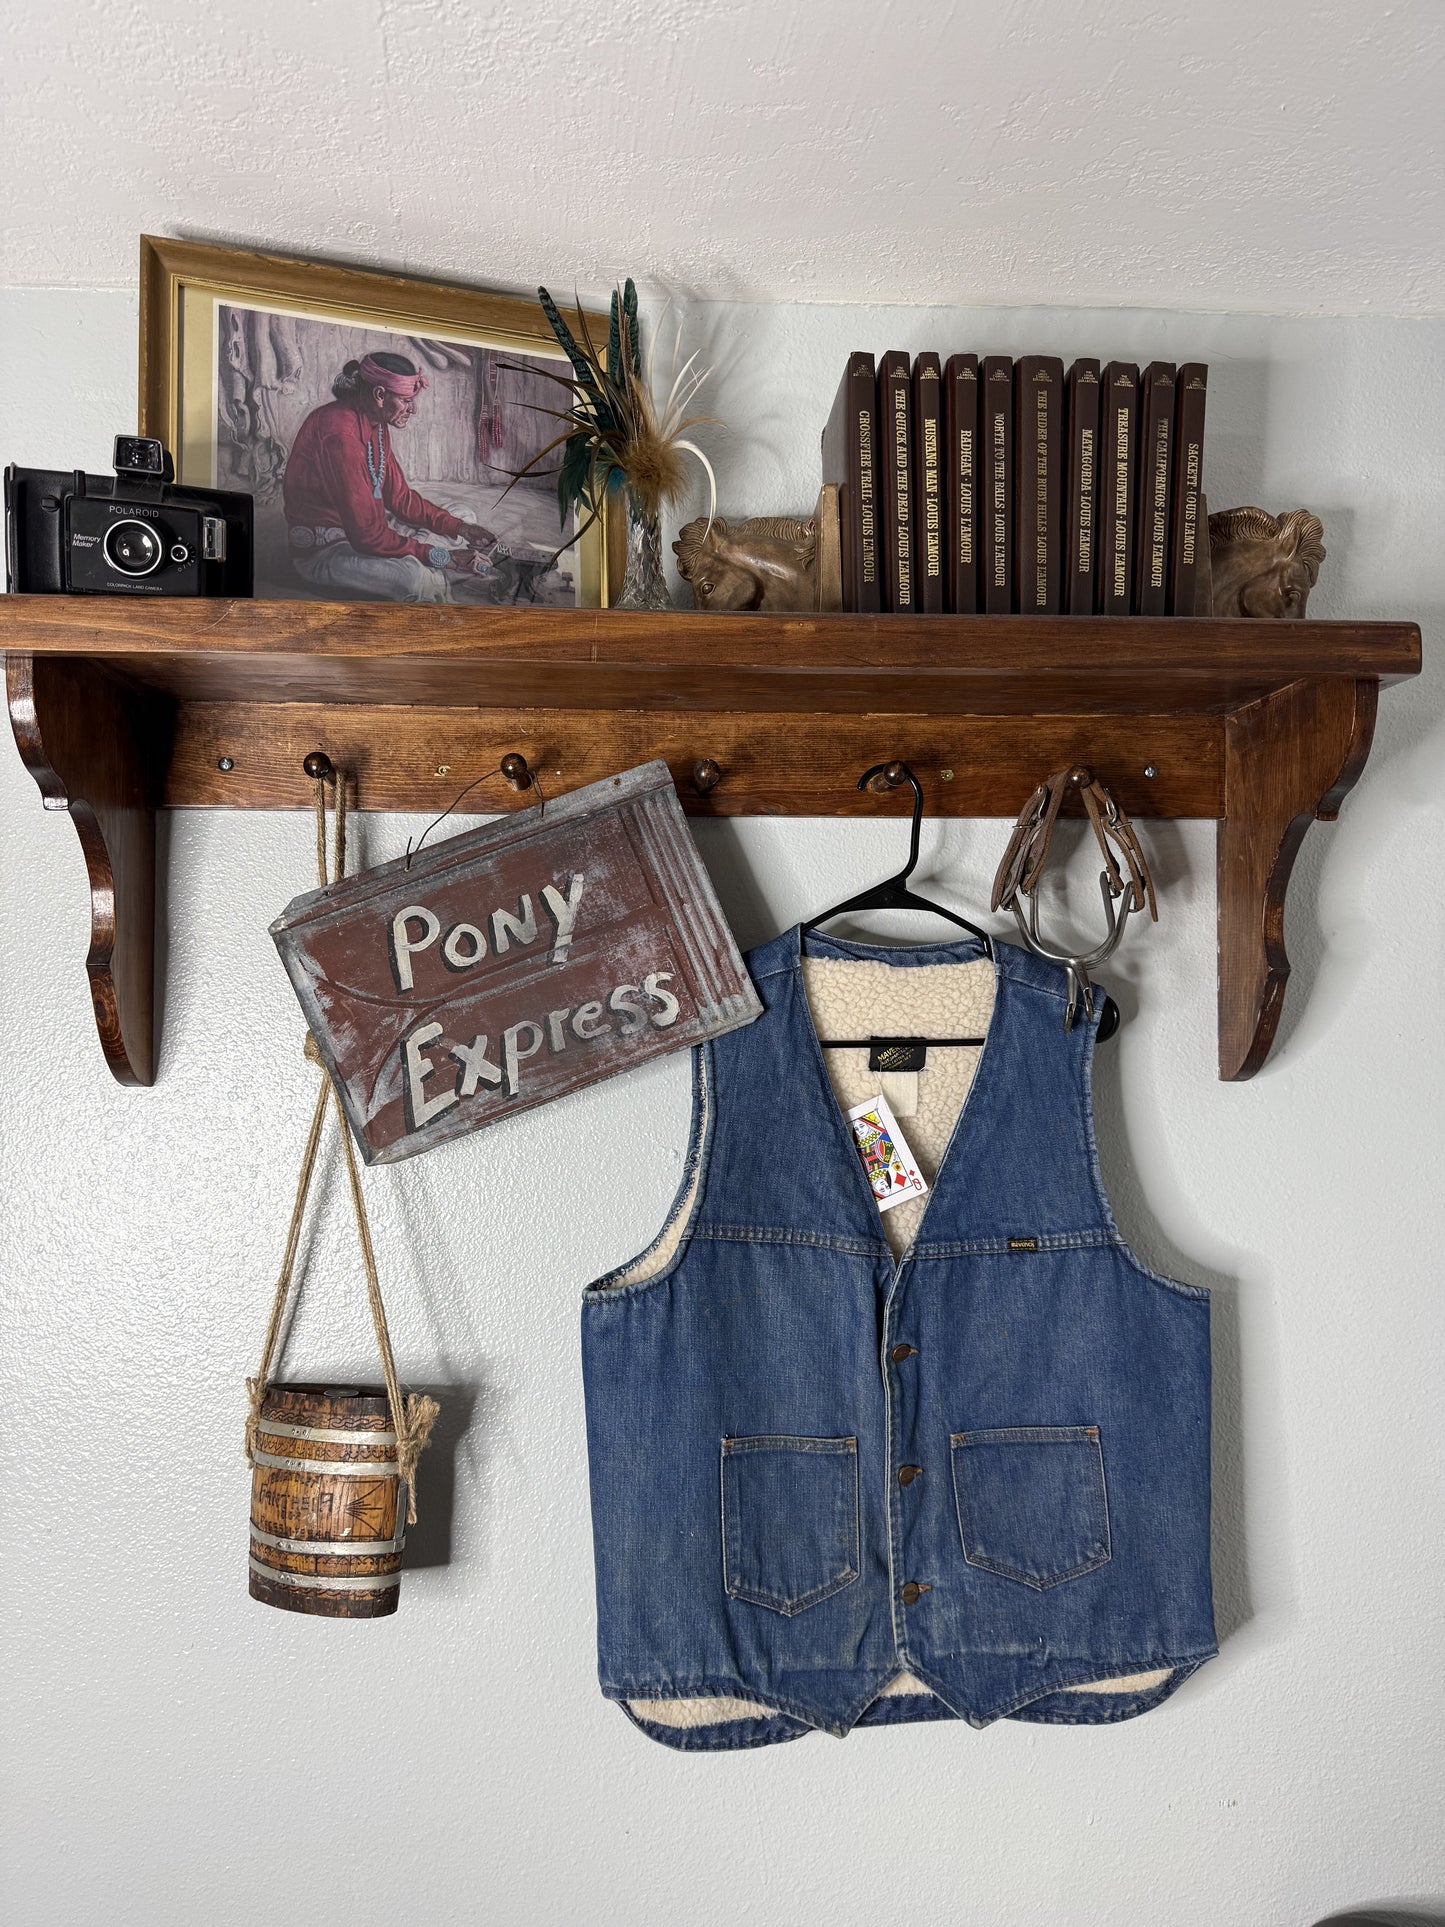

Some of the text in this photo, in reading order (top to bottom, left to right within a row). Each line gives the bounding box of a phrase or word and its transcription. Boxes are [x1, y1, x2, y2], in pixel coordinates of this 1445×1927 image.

[1037, 390, 1048, 409] THE
[1037, 411, 1048, 441] RIDER
[1037, 442, 1048, 456] OF
[1037, 457, 1048, 476] THE
[859, 410, 875, 583] CROSSFIRE TRAIL LOUIS L'AMOUR
[895, 388, 911, 605] THE QUICK AND THE DEAD LOUIS L'AMOUR
[924, 418, 940, 577] MUSTANG MAN LOUIS L'AMOUR
[960, 429, 972, 564] RADIGAN LOUIS L'AMOUR
[994, 412, 1006, 587] NORTH TO THE RAILS LOUIS L'AMOUR
[1036, 477, 1047, 503] RUBY
[1078, 428, 1093, 573] MATAGORDA LOUIS L'AMOUR
[1114, 408, 1129, 597] TREASURE MOUNTAIN LOUIS L'AMOUR
[1151, 418, 1168, 588] THE CALIFORNIOS LOUIS L'AMOUR
[1182, 443, 1199, 565] SACKETT LOUIS L'AMOUR
[109, 505, 160, 519] POLAROID
[1036, 503, 1047, 532] HILLS
[71, 540, 95, 548] Maker
[73, 533, 102, 543] Memory
[1036, 535, 1047, 564] LOUIS
[1036, 565, 1047, 606] L'AMOUR
[912, 1178, 923, 1191] Q
